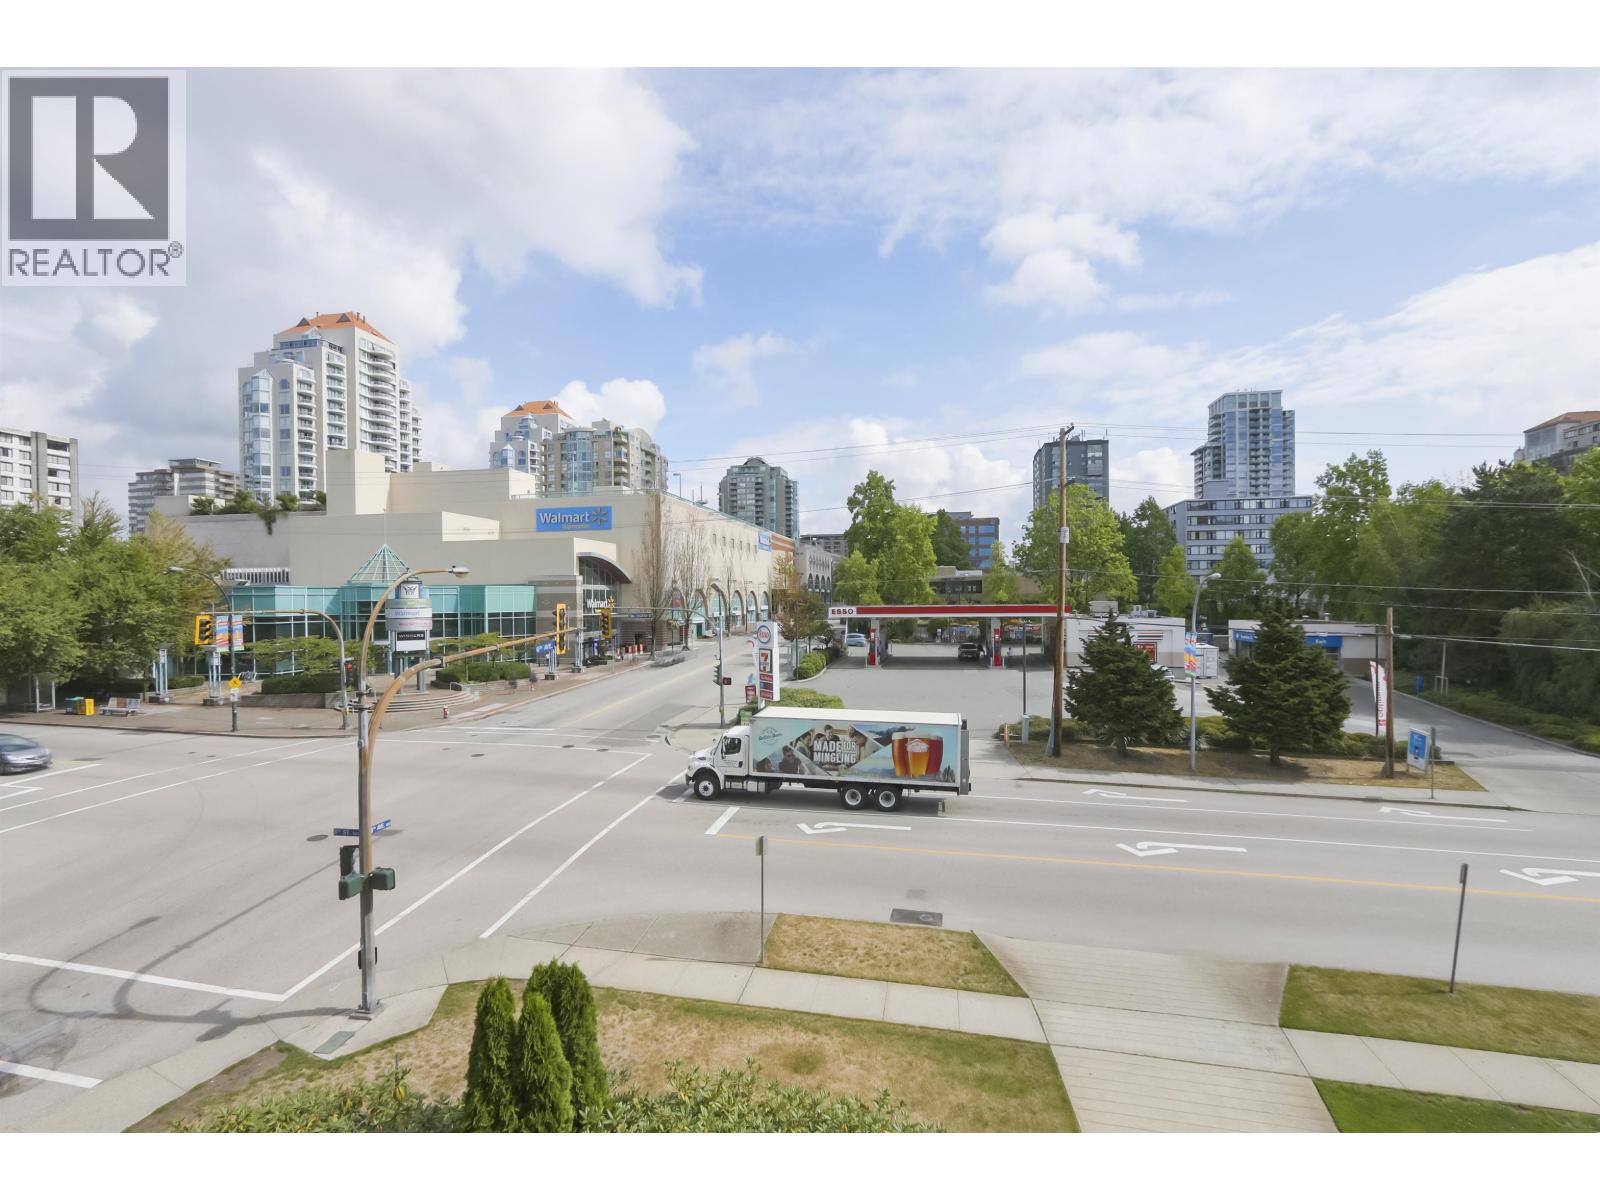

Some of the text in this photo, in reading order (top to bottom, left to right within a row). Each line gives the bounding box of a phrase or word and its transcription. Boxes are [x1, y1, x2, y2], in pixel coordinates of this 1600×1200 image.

[539, 512, 590, 524] Walmart
[586, 598, 608, 608] Walmart
[813, 740, 856, 752] MADE FOR
[813, 751, 857, 764] MINGLING
